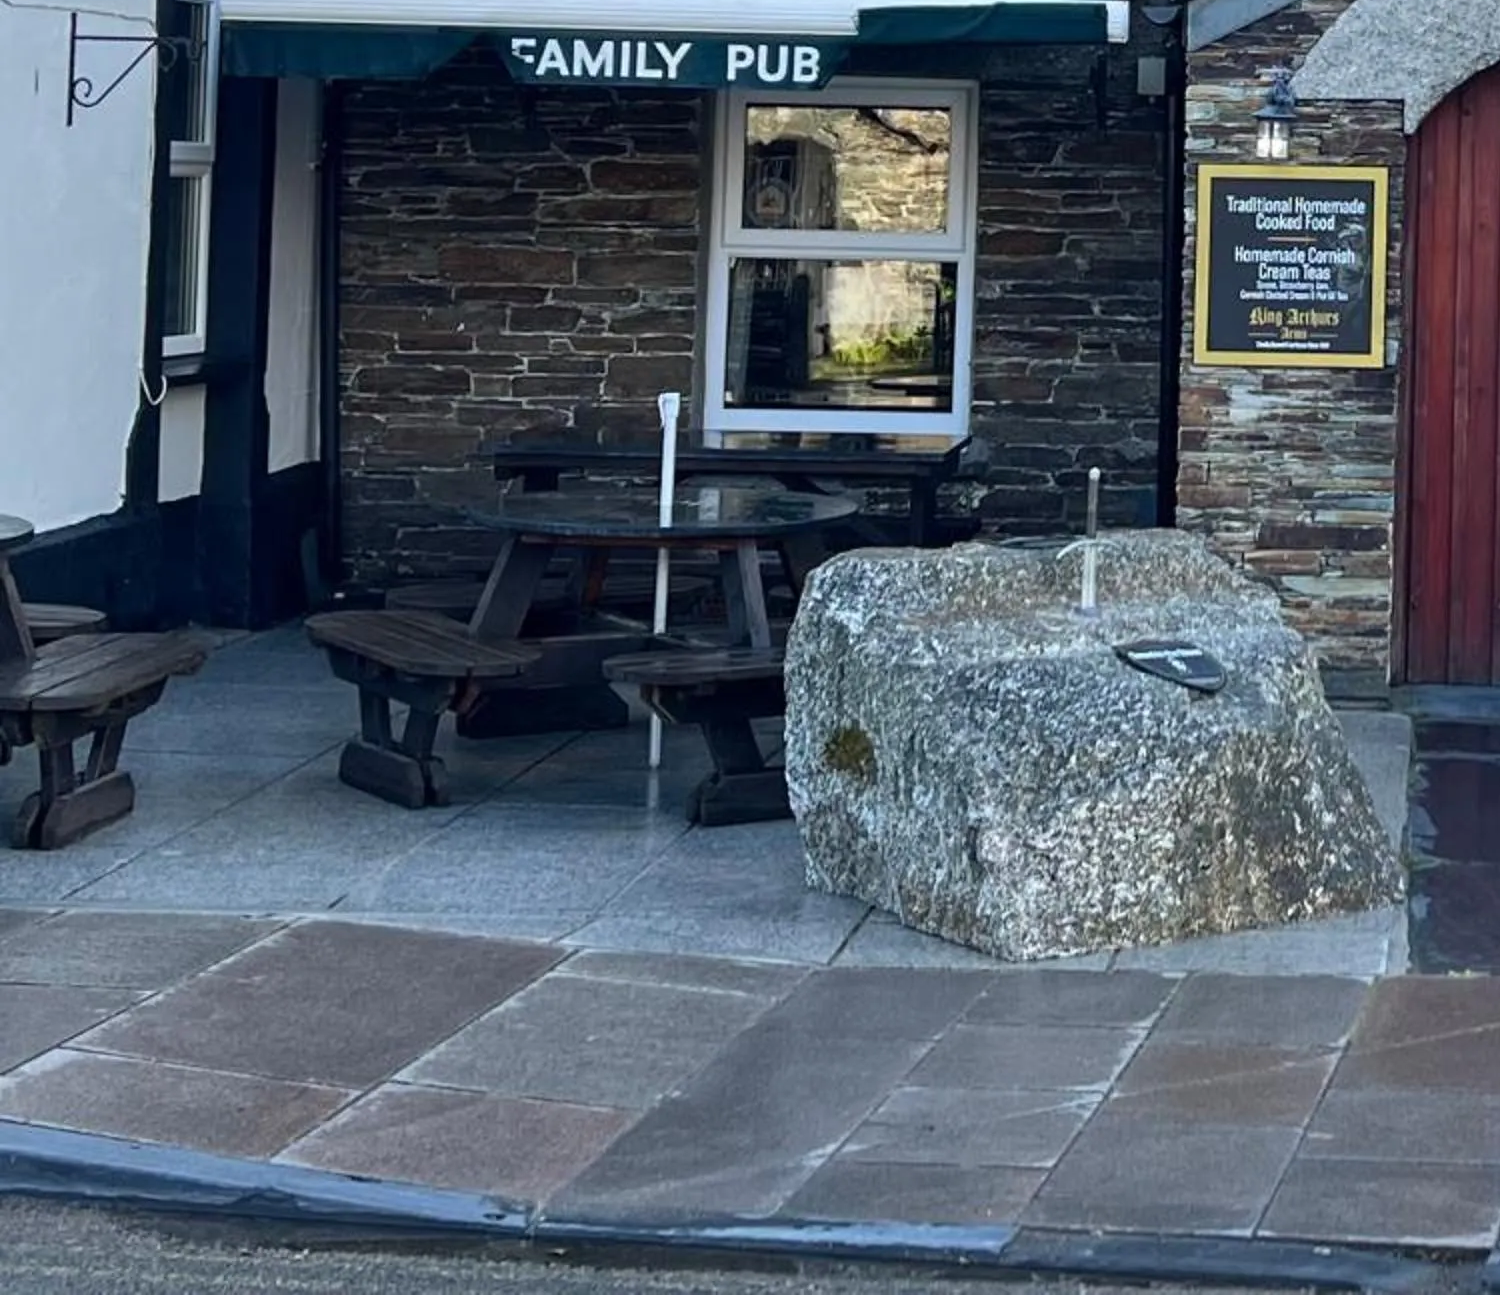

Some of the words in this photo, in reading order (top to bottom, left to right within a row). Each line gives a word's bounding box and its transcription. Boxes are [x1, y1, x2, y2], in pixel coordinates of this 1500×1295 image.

[511, 37, 693, 80] FAMILY
[726, 43, 821, 83] PUB
[1226, 194, 1293, 214] Traditional
[1294, 196, 1366, 215] Homemade
[1255, 212, 1303, 231] Cooked
[1304, 214, 1336, 231] Food
[1234, 245, 1305, 265] Homemade
[1307, 246, 1356, 265] Cornish
[1258, 263, 1300, 281] Cream
[1302, 264, 1332, 281] Teas
